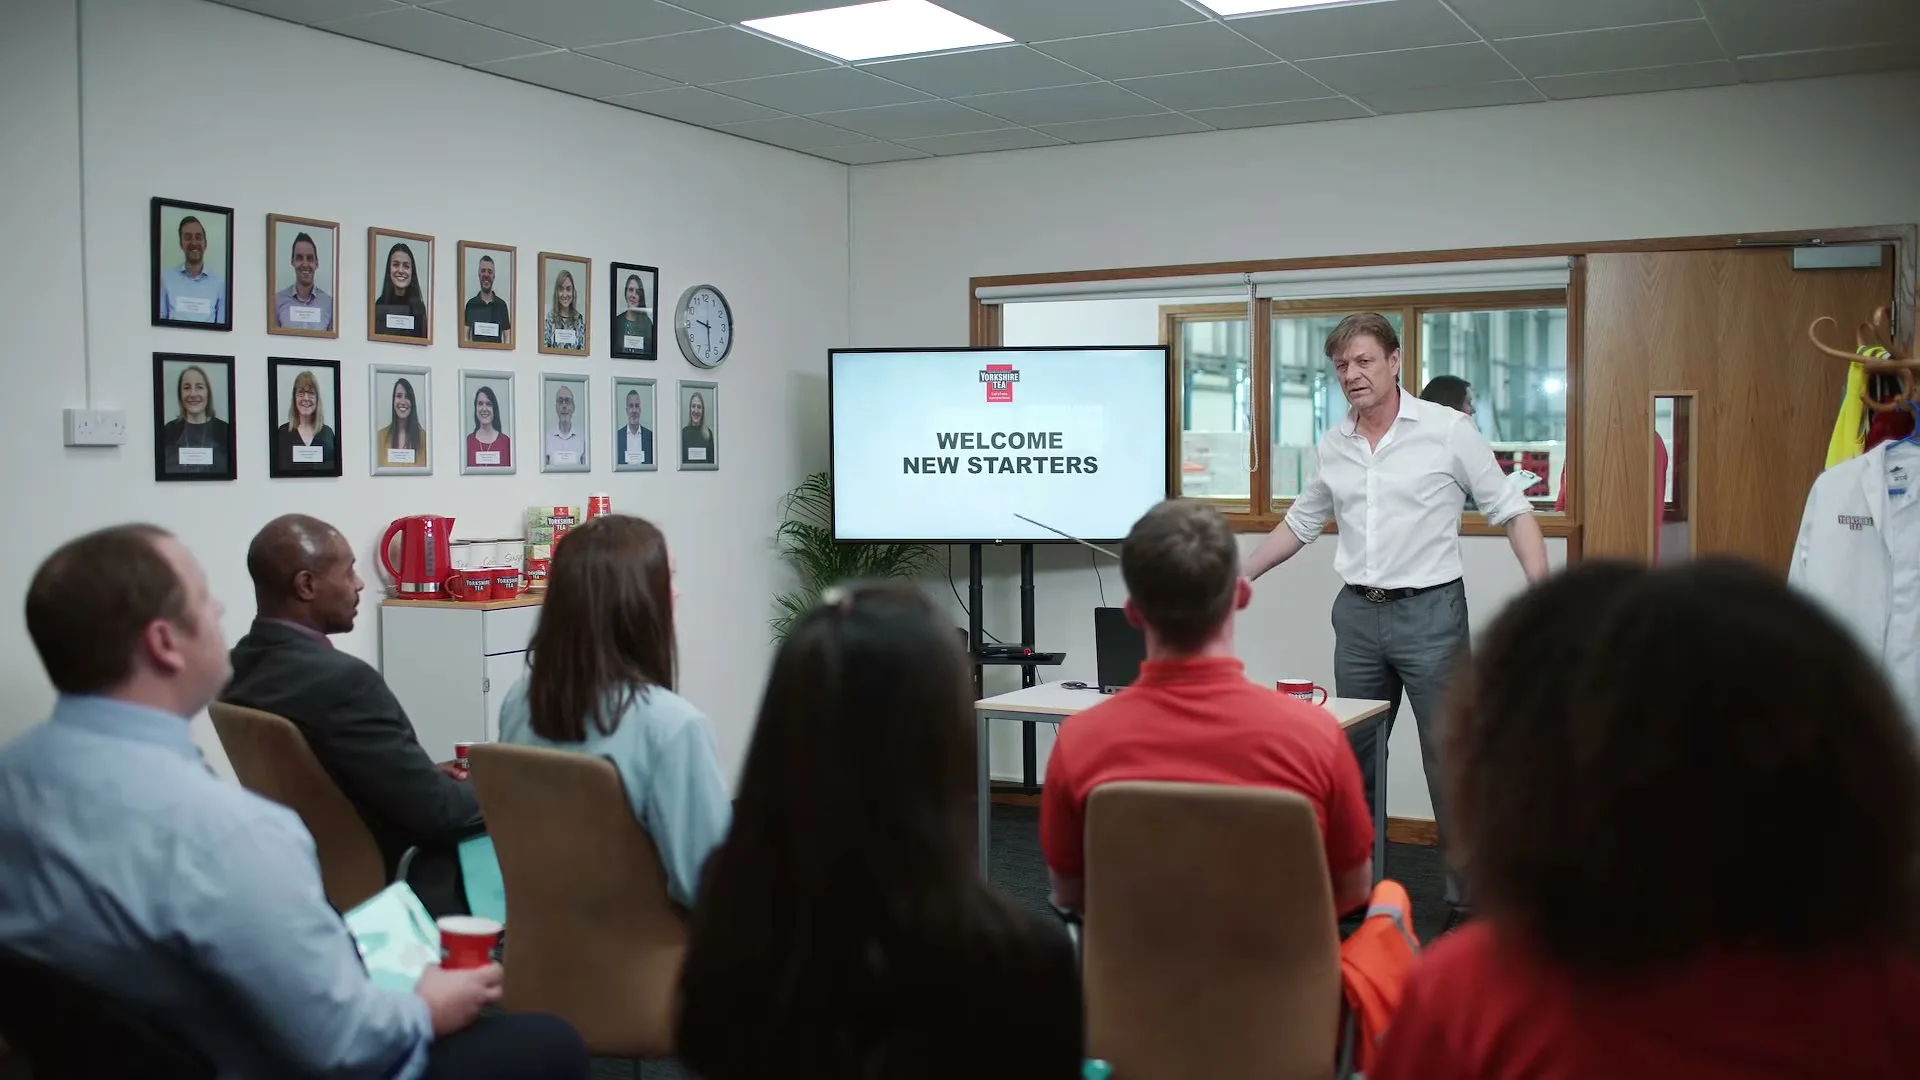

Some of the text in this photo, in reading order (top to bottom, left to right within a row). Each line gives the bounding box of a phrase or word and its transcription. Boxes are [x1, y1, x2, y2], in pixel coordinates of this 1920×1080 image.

[694, 297, 701, 305] 11
[701, 294, 709, 303] 12
[689, 306, 695, 315] 10
[718, 310, 723, 318] 2
[686, 319, 691, 328] 9
[721, 323, 726, 332] 3
[689, 333, 695, 342] 8
[696, 344, 702, 353] 7
[713, 346, 719, 355] 5
[705, 349, 710, 358] 6
[980, 371, 1019, 381] YORKSHIRE
[993, 381, 1006, 389] TEA
[936, 432, 1063, 450] WELCOME
[903, 456, 1098, 474] NEW STARTERS
[547, 517, 574, 525] YORKSHIRE
